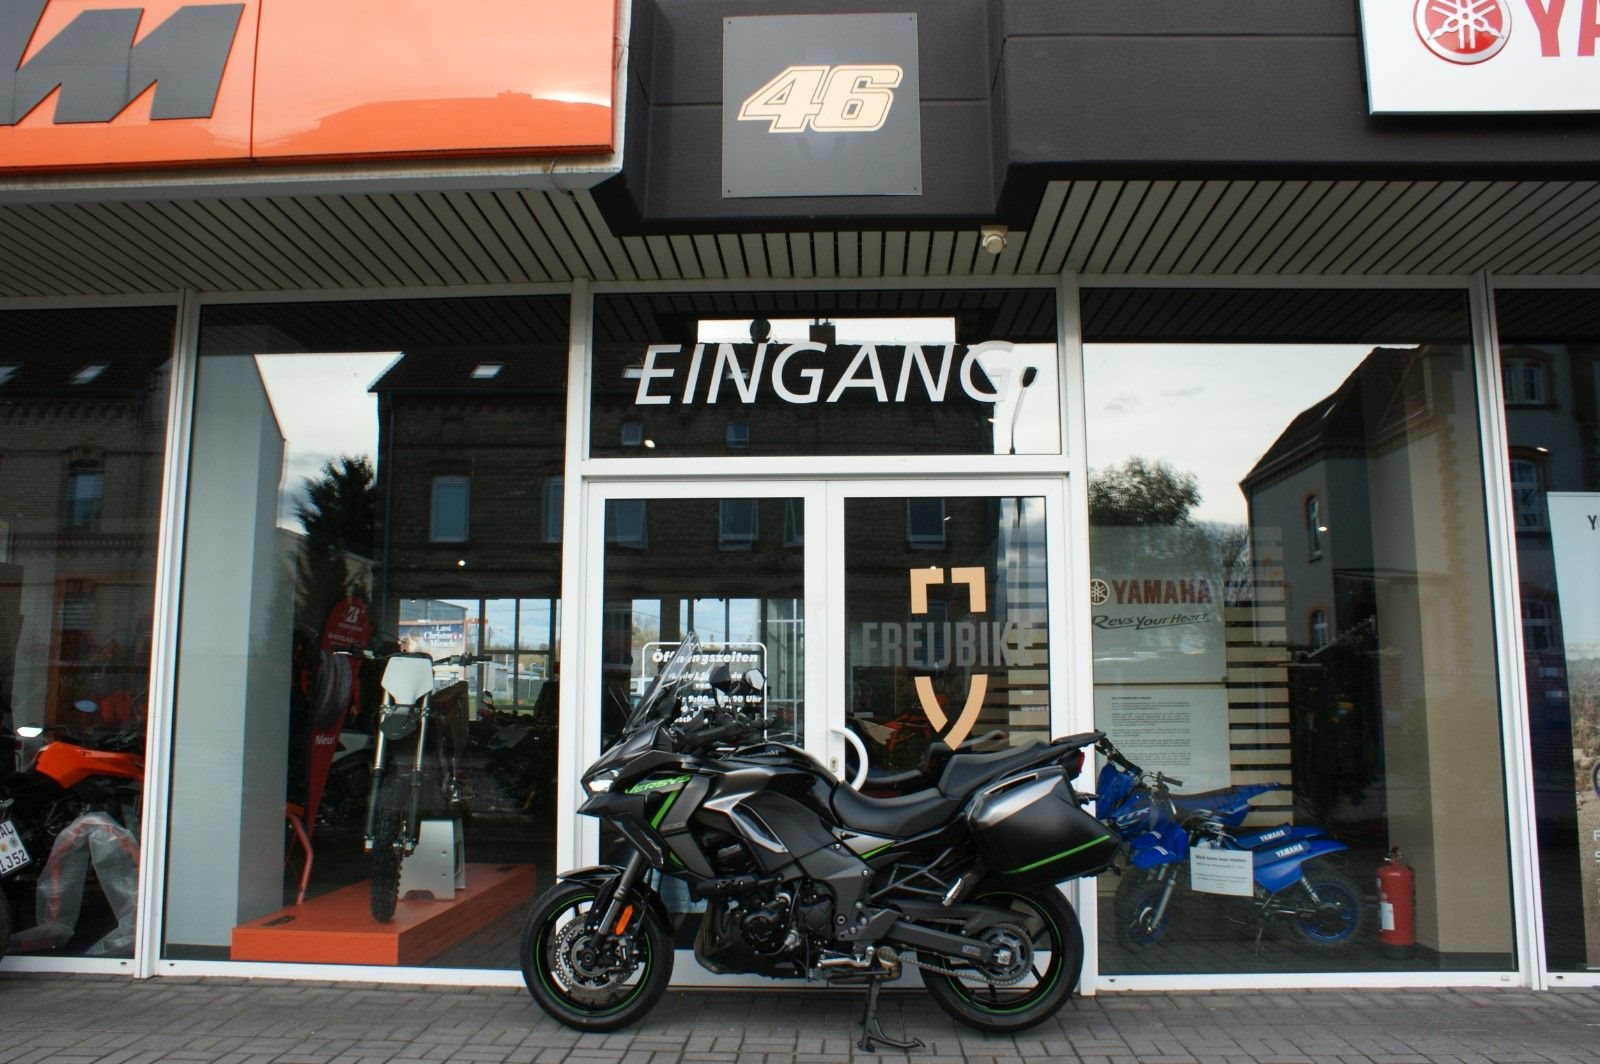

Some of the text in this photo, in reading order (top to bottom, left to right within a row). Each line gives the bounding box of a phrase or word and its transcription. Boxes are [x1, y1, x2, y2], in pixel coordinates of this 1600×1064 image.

[737, 64, 904, 133] 46
[634, 341, 1015, 405] EINGANG
[1112, 579, 1213, 604] YAMAHA
[625, 774, 692, 794] VERSYS
[1259, 829, 1285, 842] YAMAHA
[1275, 843, 1304, 858] YAMAHA
